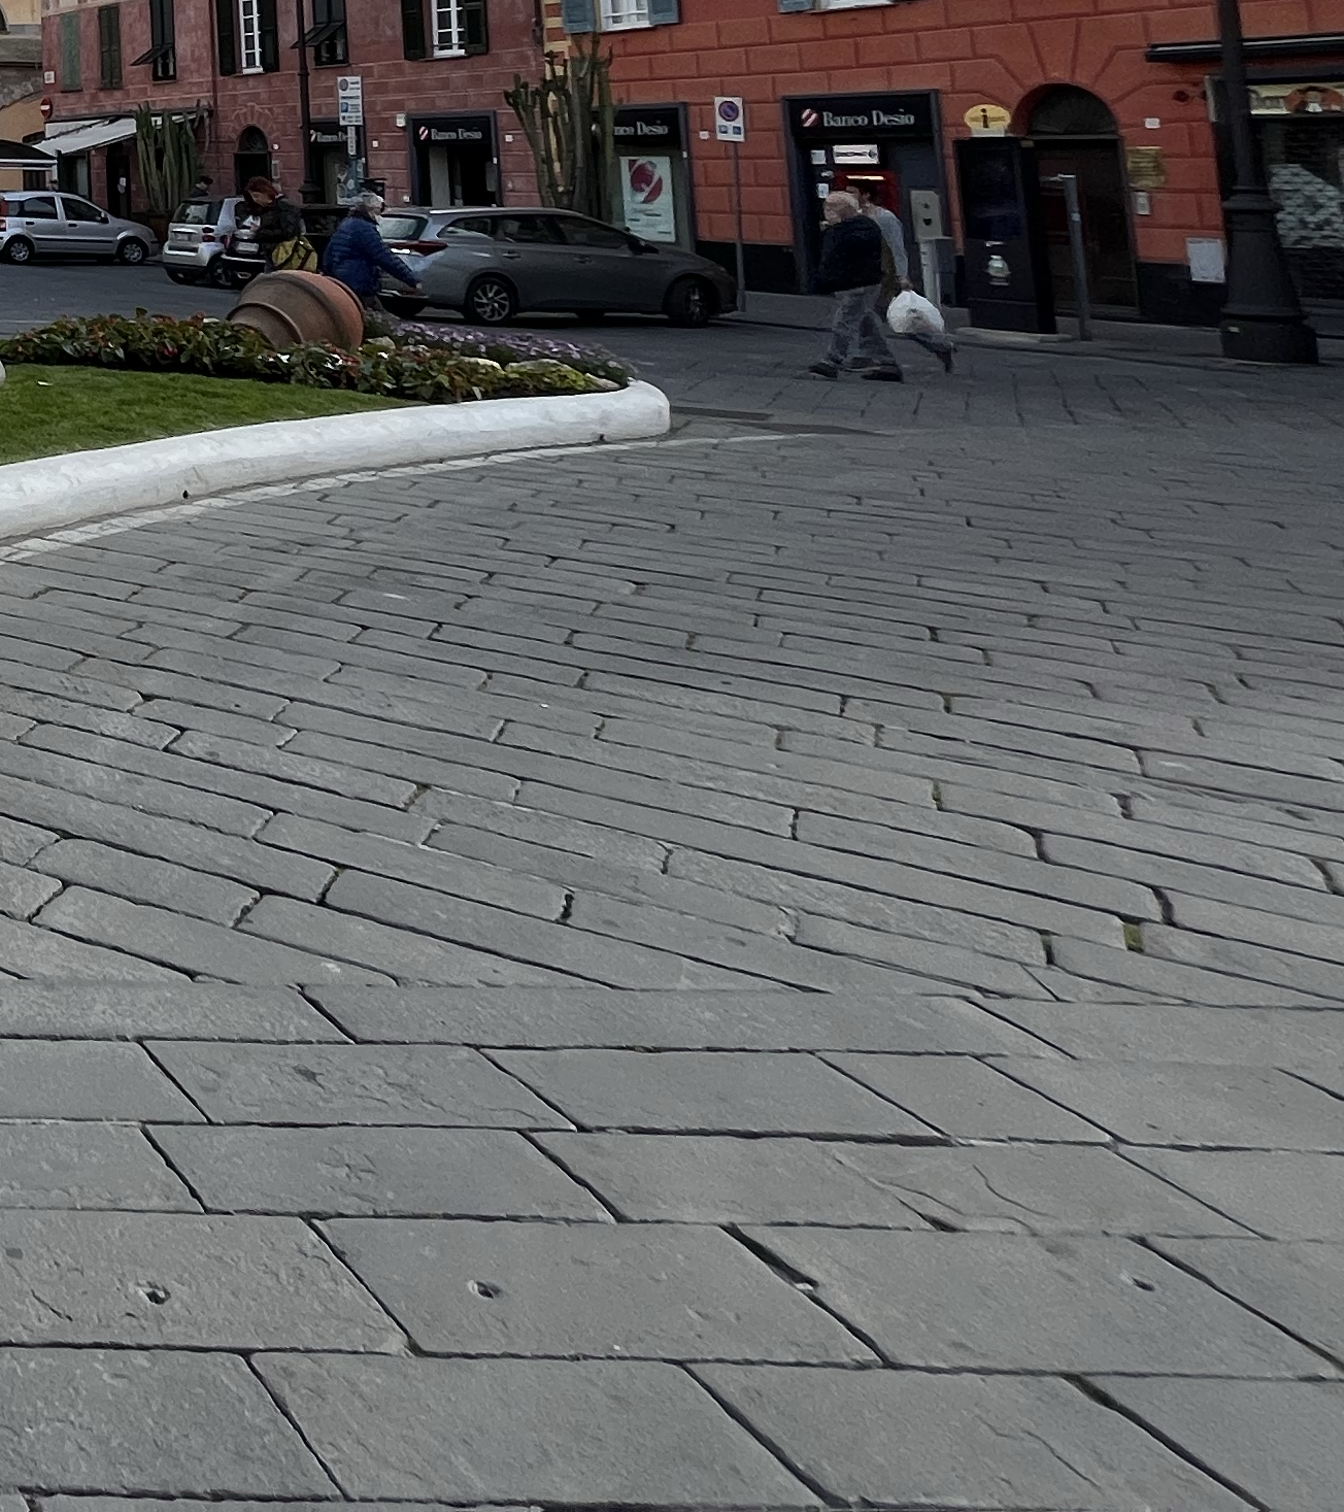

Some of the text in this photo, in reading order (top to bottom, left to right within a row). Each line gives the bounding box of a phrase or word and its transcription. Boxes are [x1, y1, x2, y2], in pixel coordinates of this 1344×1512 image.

[823, 108, 915, 127] Banco Desio
[637, 119, 669, 136] Desio
